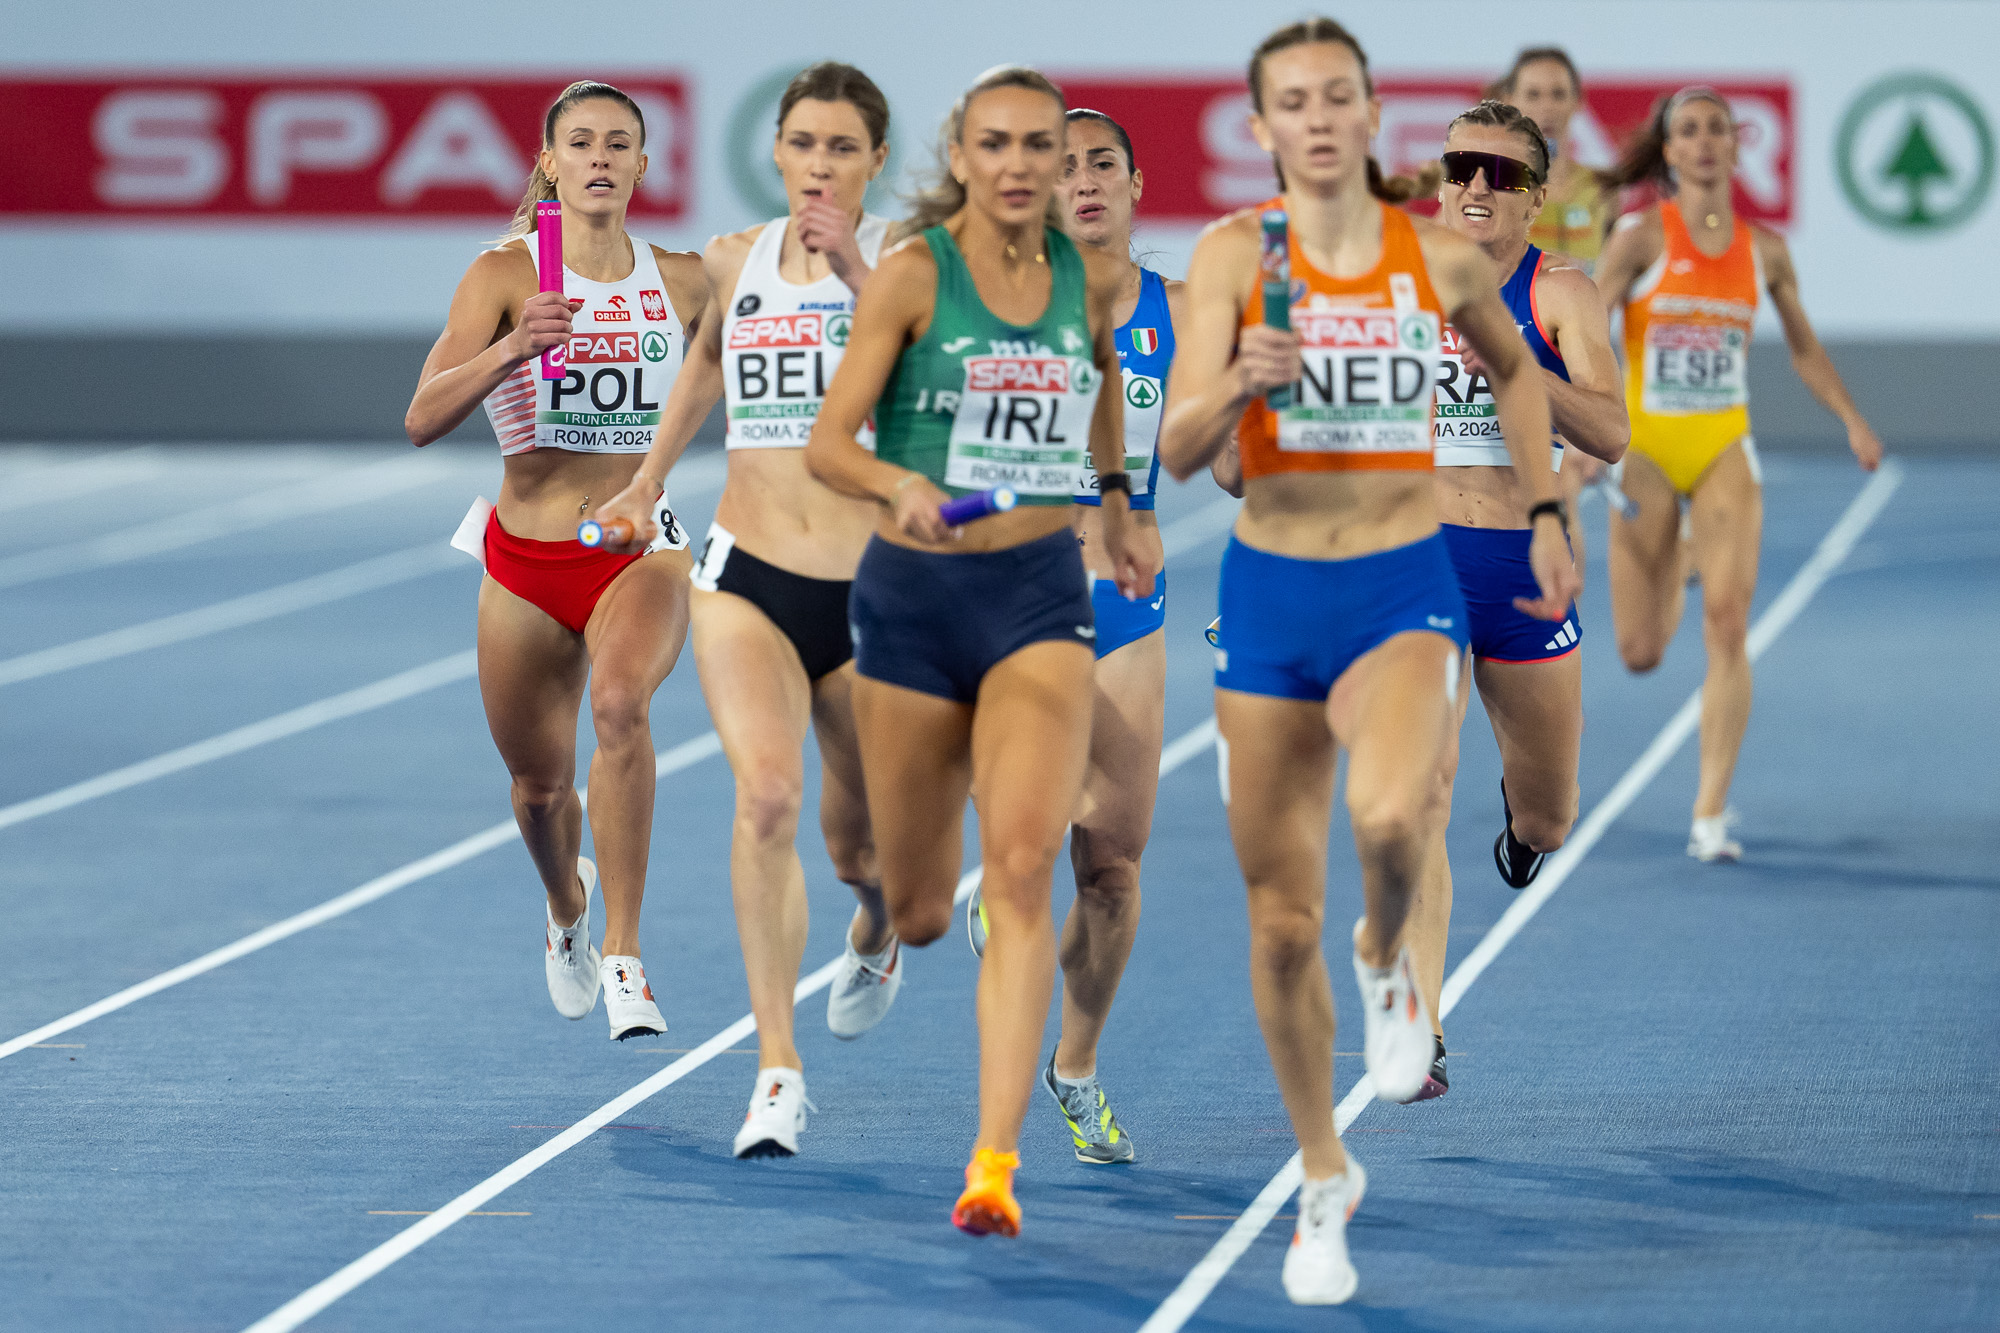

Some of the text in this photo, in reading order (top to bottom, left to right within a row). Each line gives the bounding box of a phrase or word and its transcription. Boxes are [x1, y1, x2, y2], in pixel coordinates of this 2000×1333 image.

[595, 312, 629, 320] ORLEN
[731, 318, 820, 347] SPAR
[565, 335, 637, 360] PAR
[971, 360, 1067, 390] SPAR
[1295, 356, 1426, 403] NED
[1656, 349, 1734, 386] ESP
[550, 367, 659, 412] POL
[571, 413, 600, 425] RUN
[742, 423, 794, 440] ROMA
[983, 396, 1067, 443] IRL
[1459, 420, 1502, 437] 2024
[554, 429, 653, 446] ROMA 2024
[660, 508, 681, 545] 8
